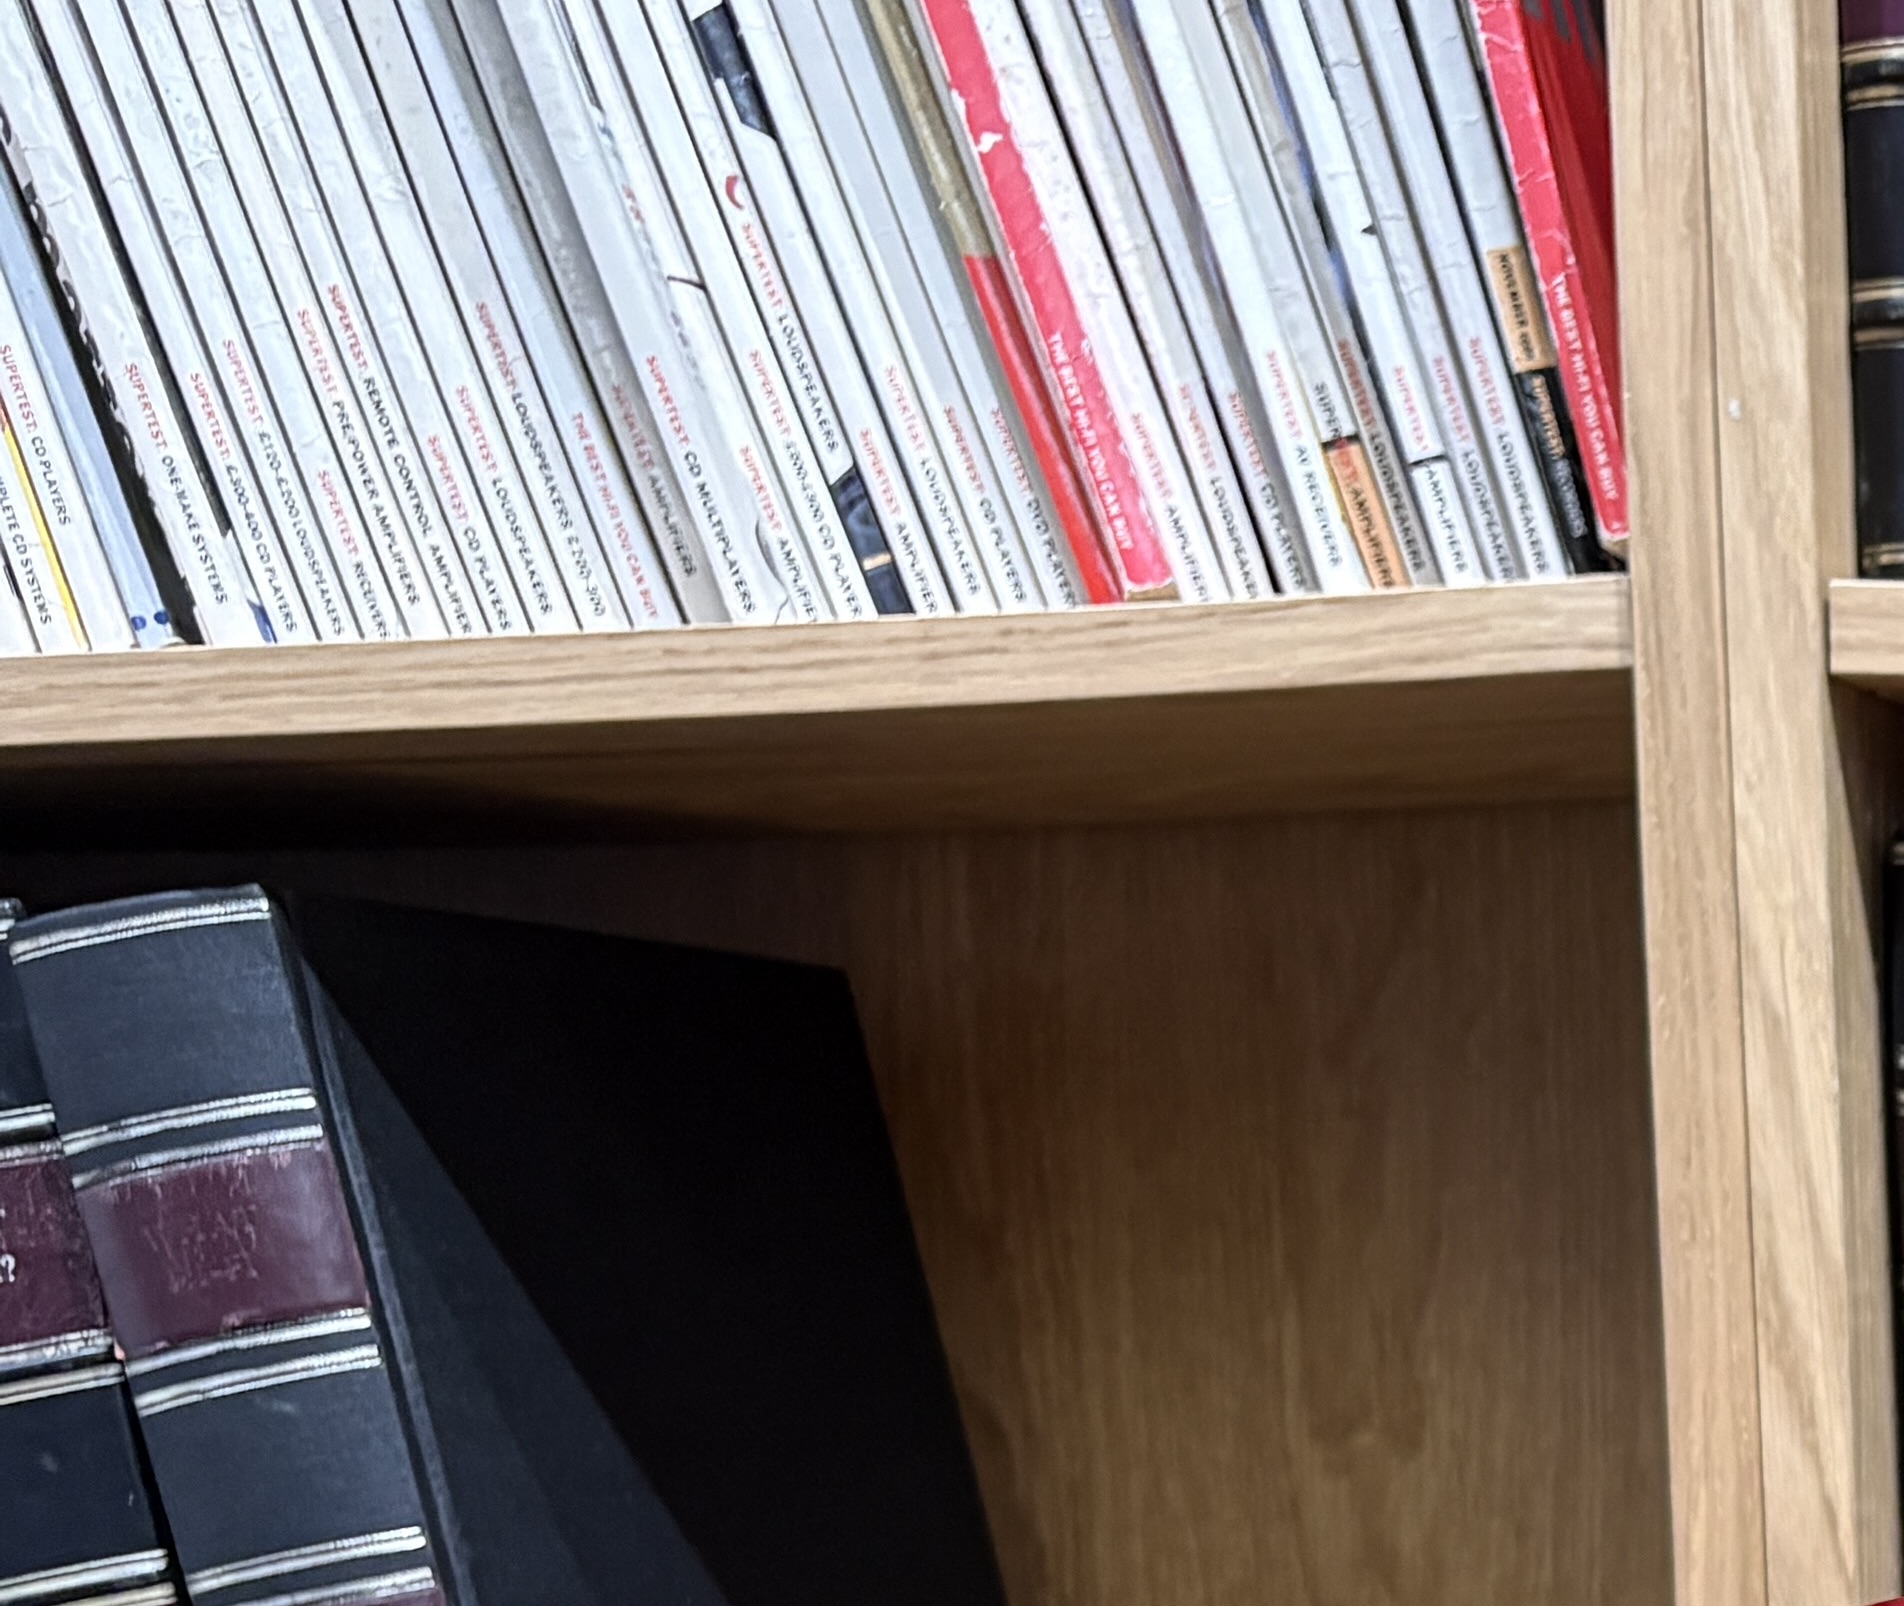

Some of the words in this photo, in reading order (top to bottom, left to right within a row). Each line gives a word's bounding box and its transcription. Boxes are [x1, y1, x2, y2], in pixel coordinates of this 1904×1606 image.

[1551, 275, 1572, 306] THE
[1558, 305, 1584, 351] BEST
[777, 313, 840, 453] LOUDSPEAKERS
[1045, 331, 1070, 366] THE
[1055, 364, 1084, 408] BEST
[29, 435, 48, 459] CD
[1070, 407, 1098, 448] HI-FI
[1578, 393, 1602, 428] YOU
[1587, 429, 1611, 465] CAN
[37, 459, 72, 526] PLAYERS
[362, 375, 400, 449] REMOTE
[392, 452, 434, 537] CONTROL
[427, 540, 473, 636] AMPLIFIER
[509, 390, 573, 530] LOUDSPEAKERS
[570, 411, 591, 441] THE
[582, 443, 608, 484] BEST
[611, 520, 634, 552] YOU
[624, 552, 647, 586] CAN
[1085, 446, 1110, 482] YOU
[1097, 481, 1122, 517] CAN
[1368, 430, 1425, 572] LOUDSPEAKERS
[1496, 432, 1550, 574] LOUDSPEAKERS
[1596, 465, 1619, 501] BUY
[11, 532, 28, 556] CD
[160, 453, 201, 532] ONE-MAKE
[191, 531, 230, 605] SYSTEMS
[371, 502, 420, 606] AMPLIFIERS
[490, 475, 553, 615] LOUDSPEAKERS
[647, 471, 698, 577] AMPLIFIERS
[682, 449, 703, 478] CD
[695, 480, 756, 615] MULTIPLAYERS
[919, 456, 981, 596] LOUDSPEAKERS
[978, 496, 997, 524] CD
[989, 525, 1027, 603] PLAYERS
[1109, 516, 1134, 552] BUY
[1269, 511, 1306, 590] PLAYERS
[1300, 470, 1344, 567] RECEIVERS
[1348, 483, 1397, 590] AMPLIFIERS
[1424, 466, 1467, 573] AMPLIFIERS
[19, 556, 53, 626] SYSTEMS
[254, 541, 273, 565] CD
[264, 564, 300, 632] PLAYERS
[292, 518, 347, 637] LOUDSPEAKERS
[462, 525, 482, 552] CD
[473, 554, 512, 631] PLAYERS
[816, 524, 835, 550] CD
[827, 551, 862, 619] PLAYER
[894, 520, 938, 614] AMPLIFIER
